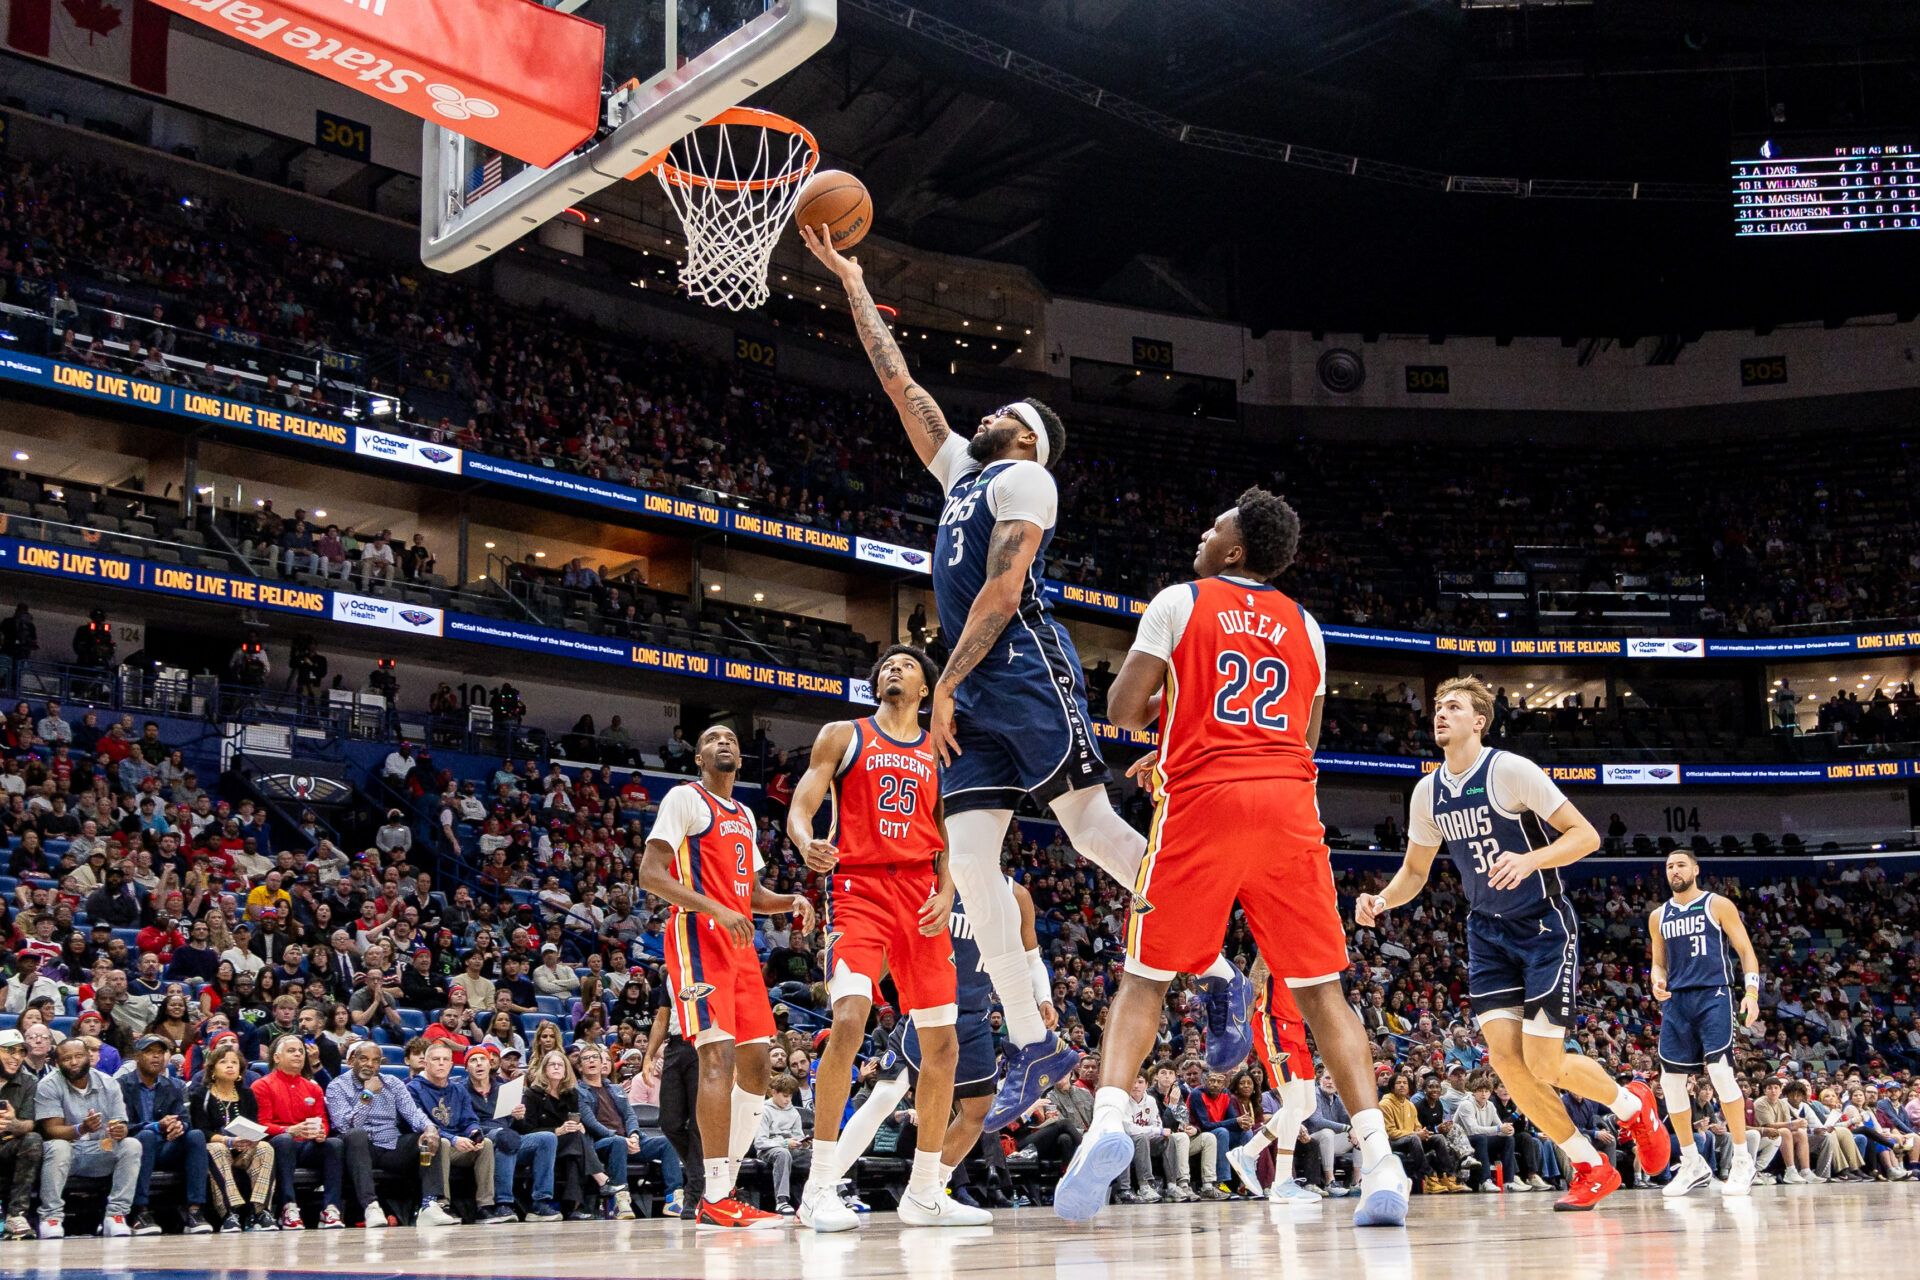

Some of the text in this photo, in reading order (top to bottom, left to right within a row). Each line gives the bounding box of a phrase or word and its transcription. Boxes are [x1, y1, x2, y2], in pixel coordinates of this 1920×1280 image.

[322, 119, 365, 151] 301
[1739, 162, 1913, 176] 3 DAVIS 4 2 0 1 0
[1739, 175, 1913, 190] 10 WILLIAMS 0 0 0 0 0
[1740, 190, 1915, 204] 13 MARSHALL 2 0 2 0 0
[1740, 204, 1915, 218] 31 THOMPSON 3 0 0 0 1
[1741, 219, 1917, 233] 32 FLAGG 0 0 1 0 0
[230, 331, 258, 347] 332
[736, 339, 775, 366] 302
[7, 360, 42, 374] Pelicans
[323, 354, 346, 369] 301
[54, 366, 161, 405] LONG LIVE YOU
[1409, 370, 1446, 389] 304
[185, 395, 346, 444] LONG LIVE THE PELICANS
[373, 435, 409, 450] Ochsner
[373, 445, 397, 456] Health
[469, 460, 637, 502] Official Healthcare Provider of the New Orleans Pelicans
[645, 495, 718, 523] LONG LIVE YOU
[735, 515, 849, 551] LONG LIVE THE PELICANS
[868, 543, 894, 555] Ochsner
[868, 551, 886, 560] Health
[948, 527, 964, 567] 3
[18, 546, 130, 580] LONG LIVE YOU
[155, 568, 324, 611] LONG LIVE THE PELICANS
[1064, 586, 1118, 608] LONG LIVE YOU
[350, 600, 389, 614] Ochsner
[350, 610, 376, 620] Health
[119, 627, 139, 642] 124
[1217, 609, 1288, 646] QUEEN
[451, 620, 624, 656] Official Healthcare Provider of the New Orleans Pelicans
[1436, 637, 1496, 652] LONG LIVE YOU
[1512, 640, 1621, 653] LONG LIVE THE PELICANS
[1639, 641, 1665, 649] Ochsner
[1857, 633, 1920, 649] LONG LIVE YO
[632, 647, 708, 673] LONG LIVE YOU
[726, 662, 751, 680] LONG
[754, 667, 774, 684] LIVE
[777, 671, 795, 688] THE
[798, 674, 842, 695] PELICANS
[1213, 649, 1290, 732] 22
[664, 706, 677, 718] 101
[1103, 724, 1119, 739] YOU
[1131, 730, 1150, 744] LONG
[866, 753, 932, 783] CRESCENT
[1553, 767, 1596, 780] PELICANS
[1828, 763, 1898, 778] LONG LIVE YOU
[877, 774, 918, 816] 25
[1466, 786, 1485, 796] chime
[880, 818, 910, 839] CITY
[1663, 807, 1701, 833] 104
[735, 842, 747, 876] 2
[1468, 838, 1500, 875] 32
[734, 880, 750, 898] CITY
[1689, 935, 1708, 957] 31
